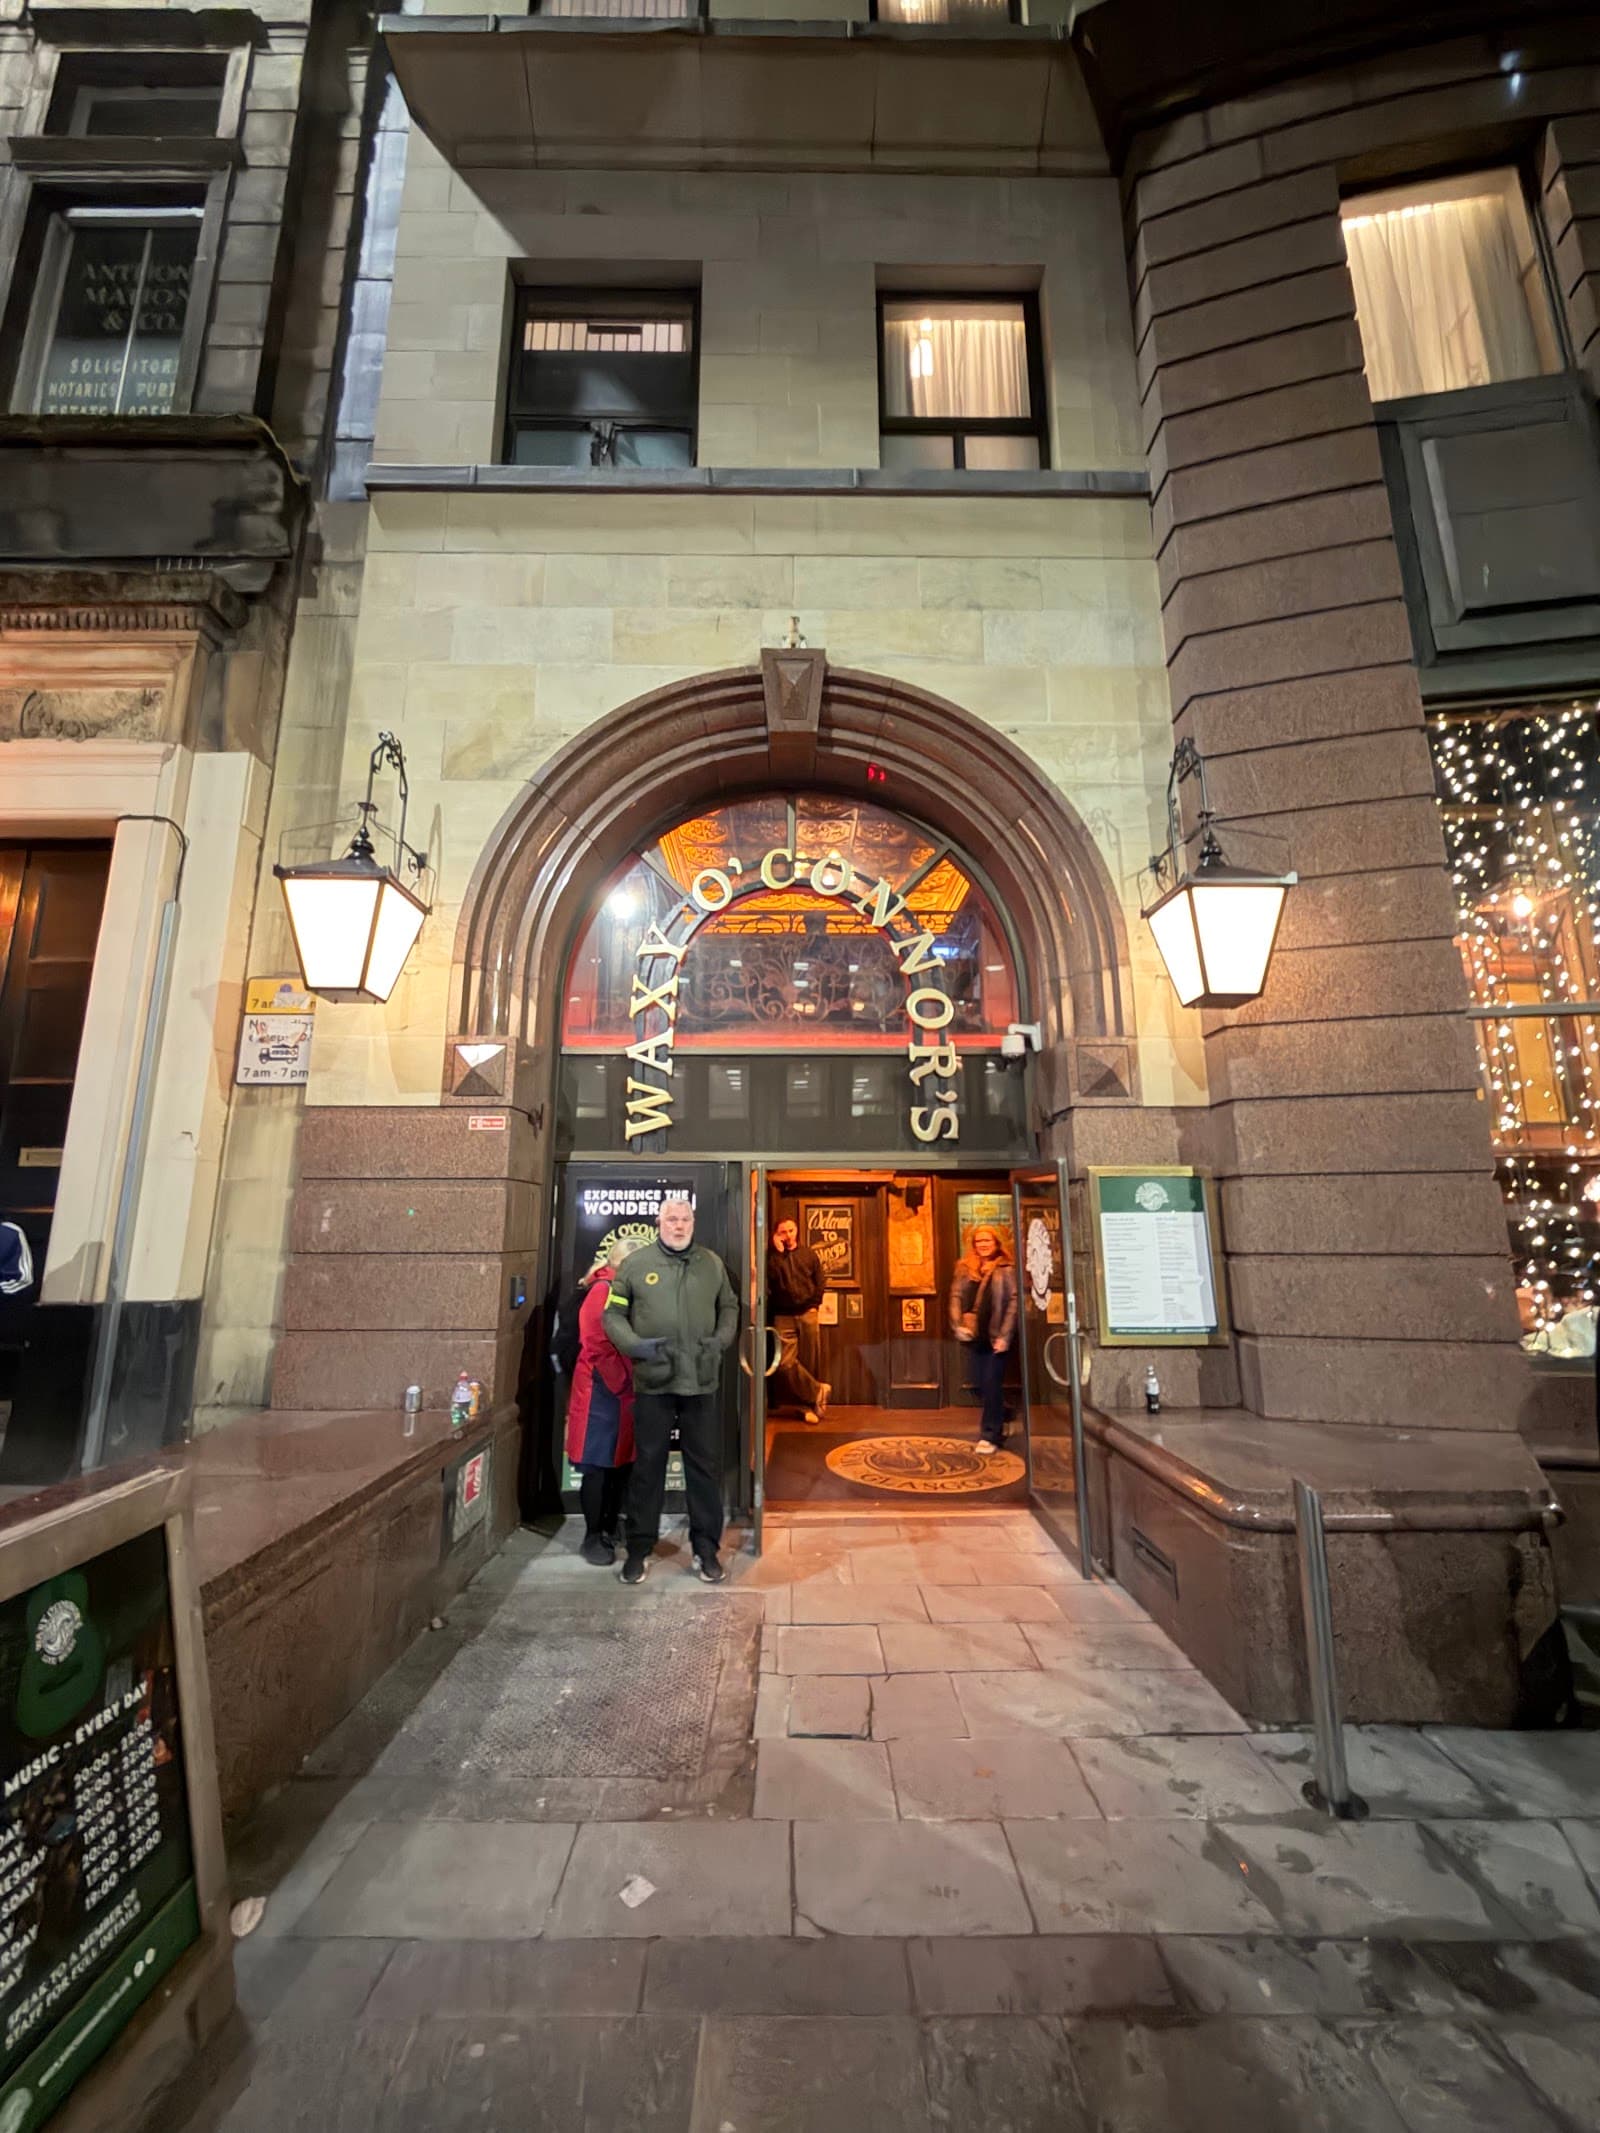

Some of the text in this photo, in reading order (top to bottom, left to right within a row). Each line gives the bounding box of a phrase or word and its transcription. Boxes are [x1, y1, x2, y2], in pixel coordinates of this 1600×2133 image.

[624, 847, 960, 1144] WAXY O'CONNOR'S
[243, 1067, 251, 1078] 7
[252, 1069, 271, 1078] am
[280, 1067, 289, 1078] 7
[290, 1069, 309, 1079] pm
[583, 1190, 689, 1201] EXPERIENCE THE
[821, 1230, 838, 1242] TO
[4, 1744, 60, 1798] MUSIC
[75, 1700, 120, 1745] EVERY
[123, 1680, 148, 1709] DAY
[51, 1961, 67, 1984] TO
[69, 1951, 78, 1966] A
[5, 2002, 43, 2050] STAFF
[46, 1976, 70, 2007] FOR
